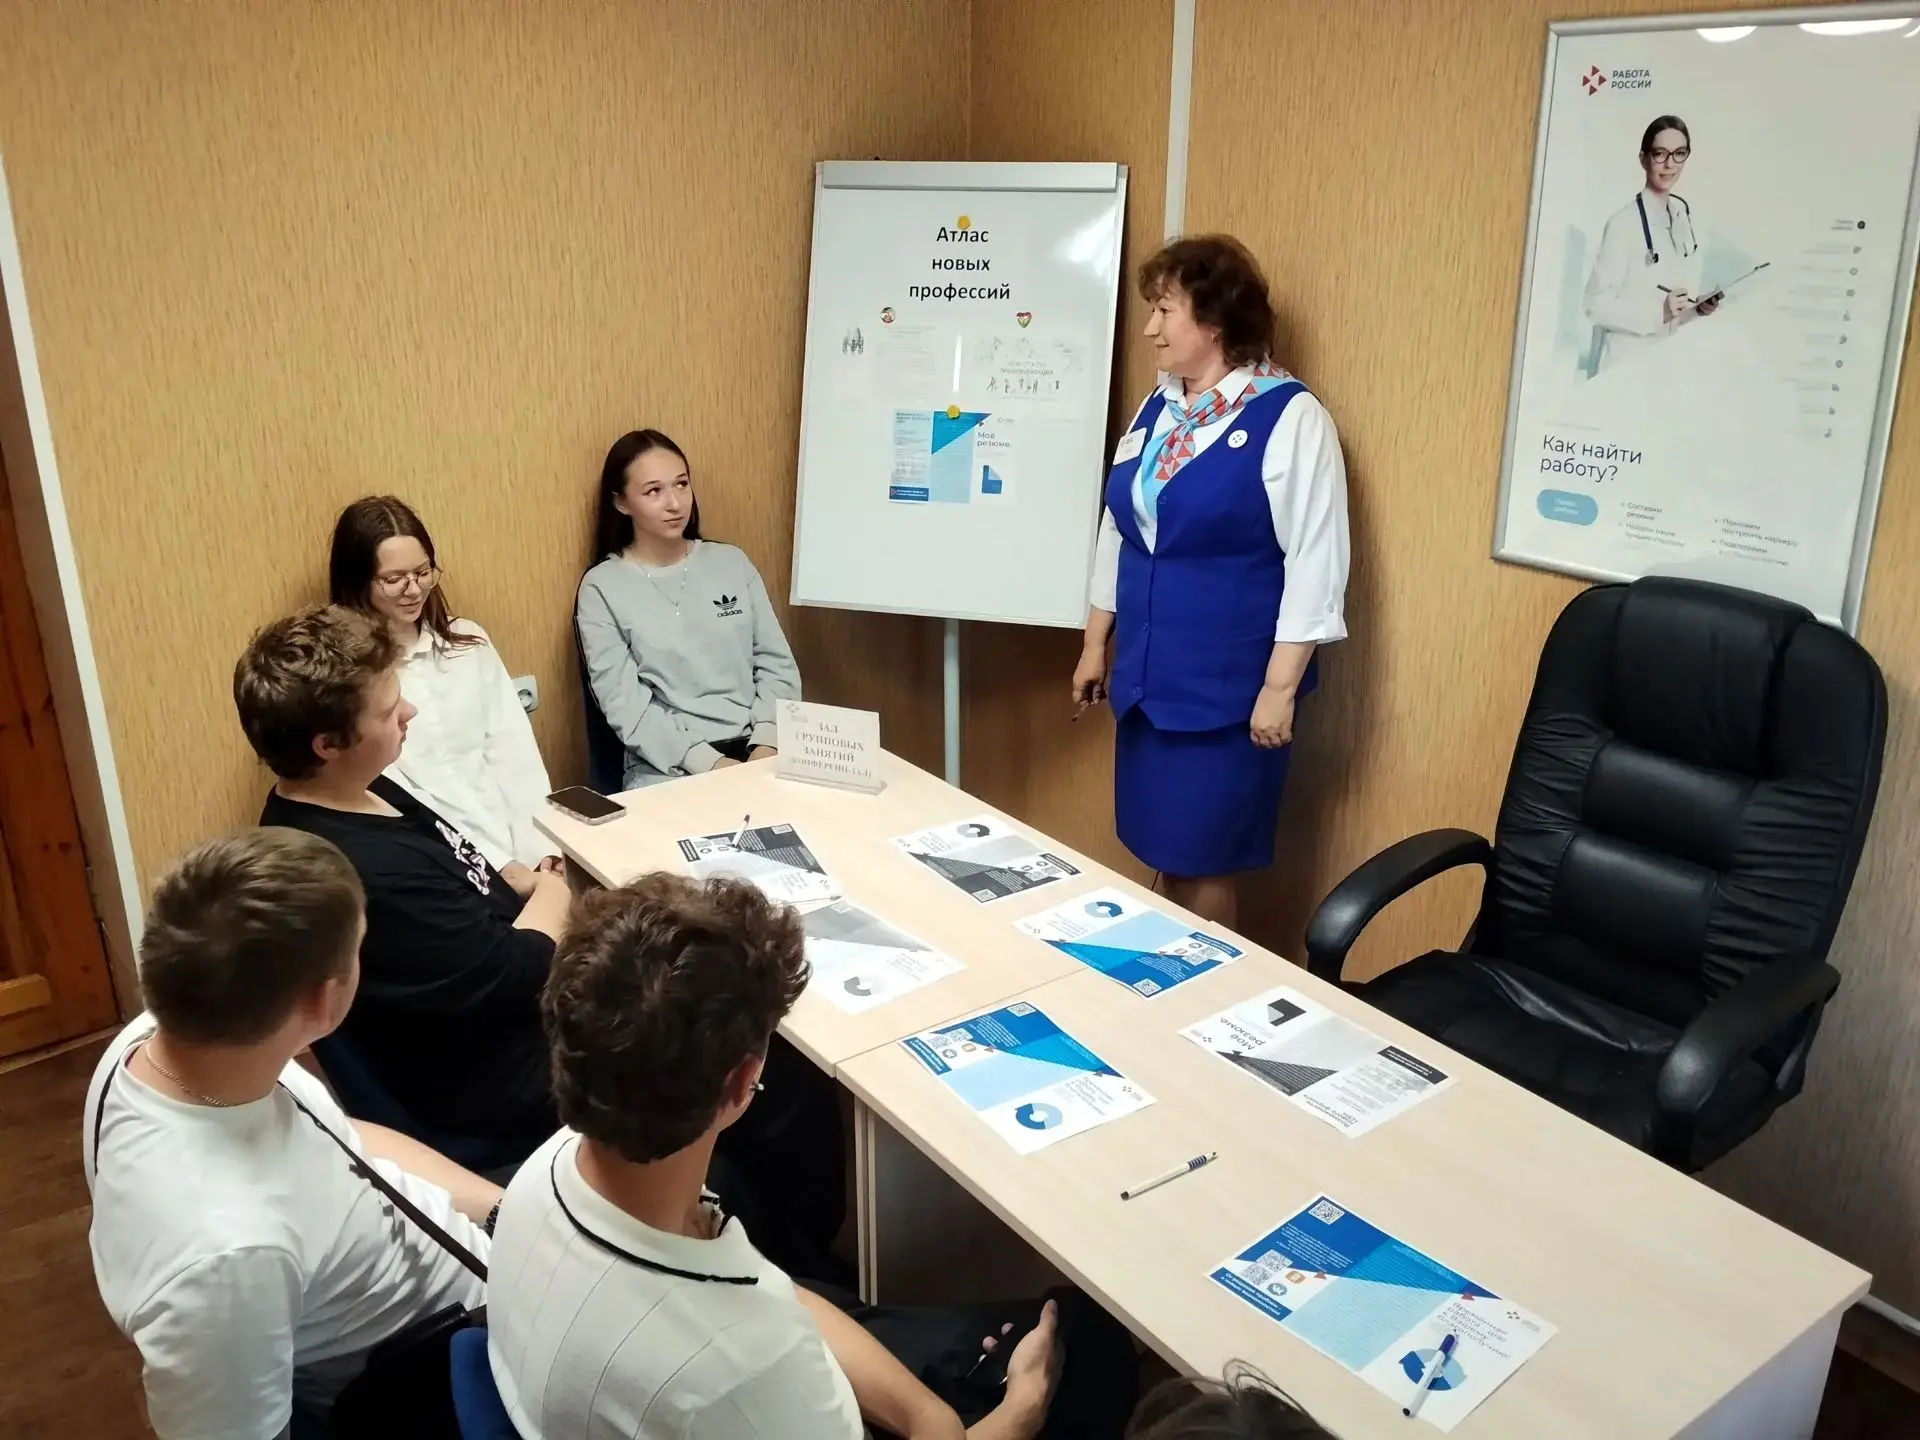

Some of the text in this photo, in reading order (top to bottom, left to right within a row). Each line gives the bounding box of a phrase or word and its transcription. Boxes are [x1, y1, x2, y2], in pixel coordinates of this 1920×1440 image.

[1612, 69, 1650, 79] РАБОТА
[1611, 80, 1652, 89] РОССИИ
[936, 226, 989, 243] Атлас
[932, 258, 991, 271] новых
[909, 282, 1010, 302] профессий
[1543, 434, 1642, 464] Как найти
[1540, 457, 1618, 483] работу?
[717, 609, 743, 618] adidas
[819, 723, 838, 733] ЗАЛ
[795, 731, 864, 751] ГРУППОВЫХ
[805, 746, 855, 763] ЗАНЯТИЙ
